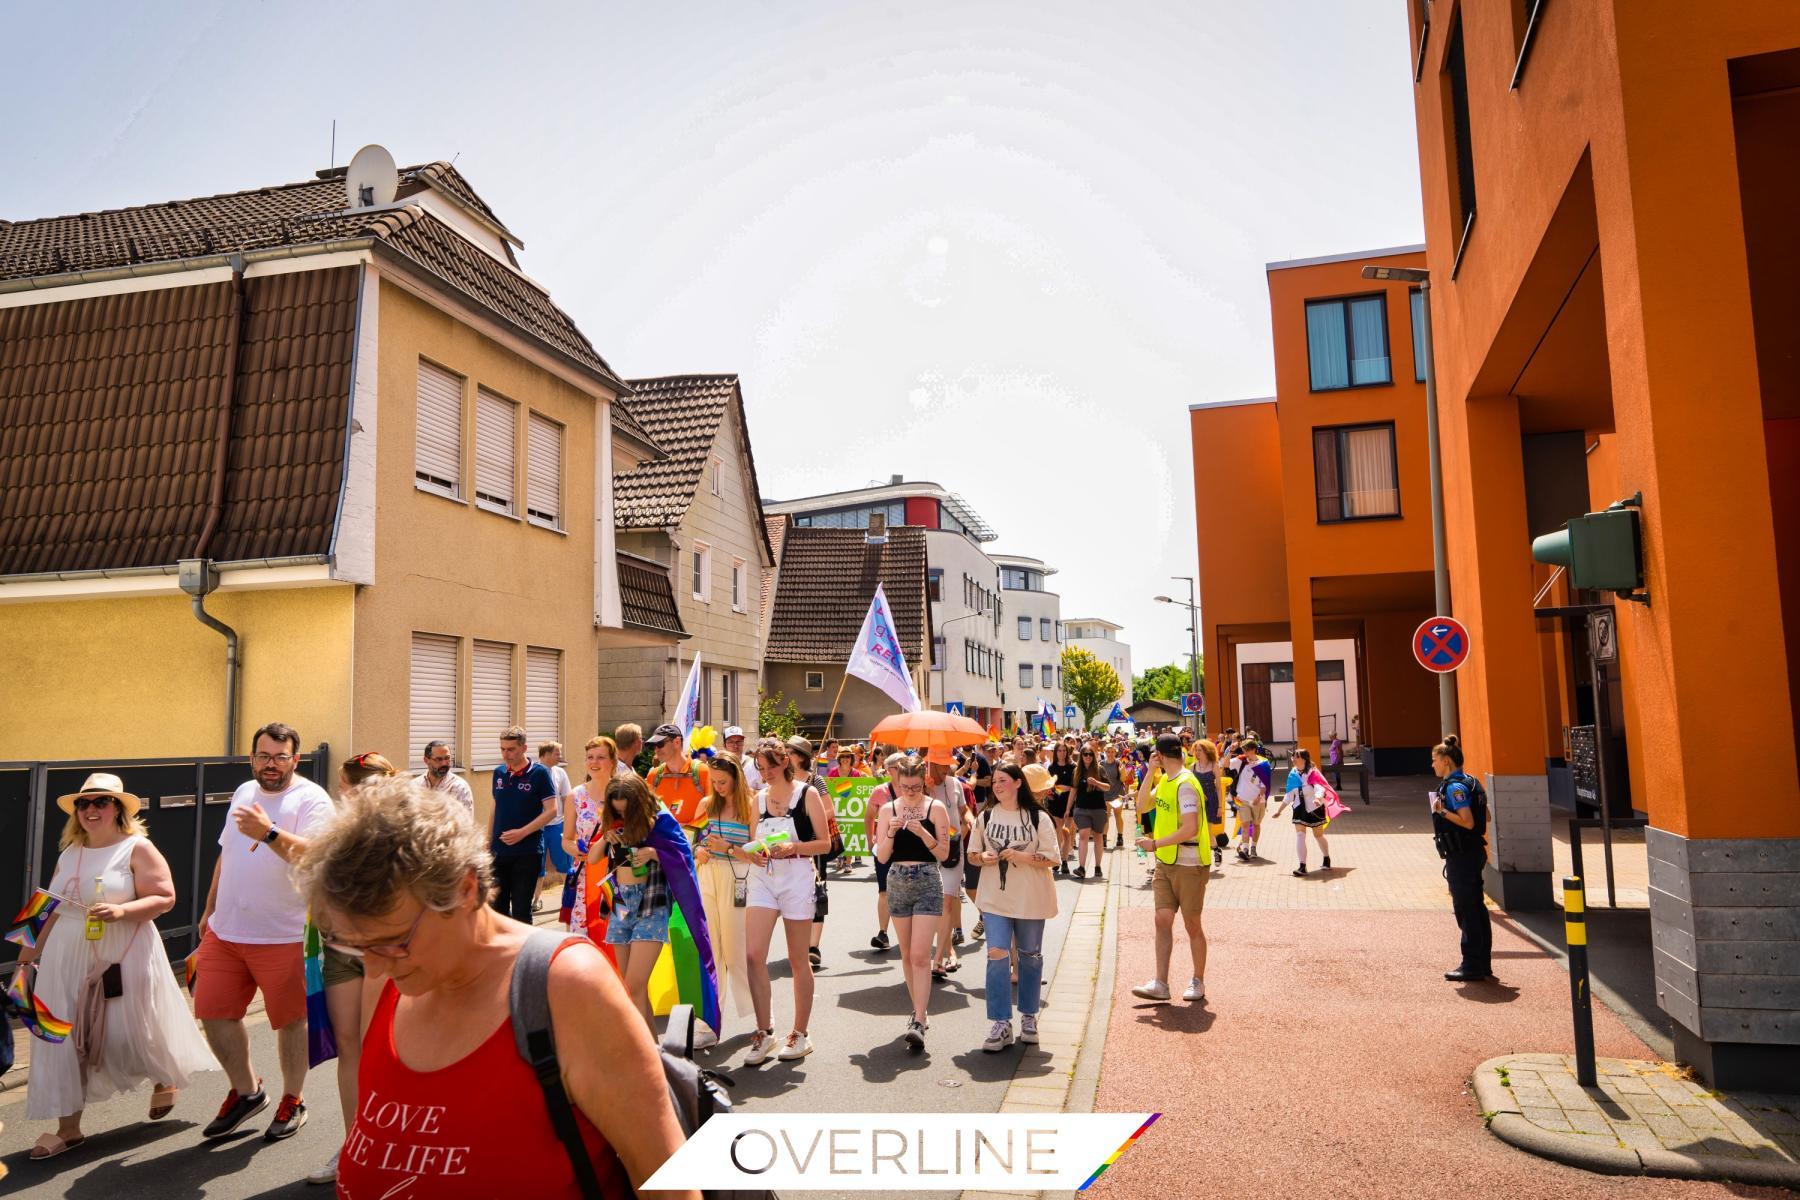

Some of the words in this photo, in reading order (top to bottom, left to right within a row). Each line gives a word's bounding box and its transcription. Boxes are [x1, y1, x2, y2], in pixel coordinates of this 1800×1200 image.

[837, 823, 853, 834] OT
[986, 822, 1033, 842] NIRVANA
[362, 1090, 446, 1134] LOVE
[345, 1120, 374, 1166] HE
[378, 1142, 470, 1175] LIFE
